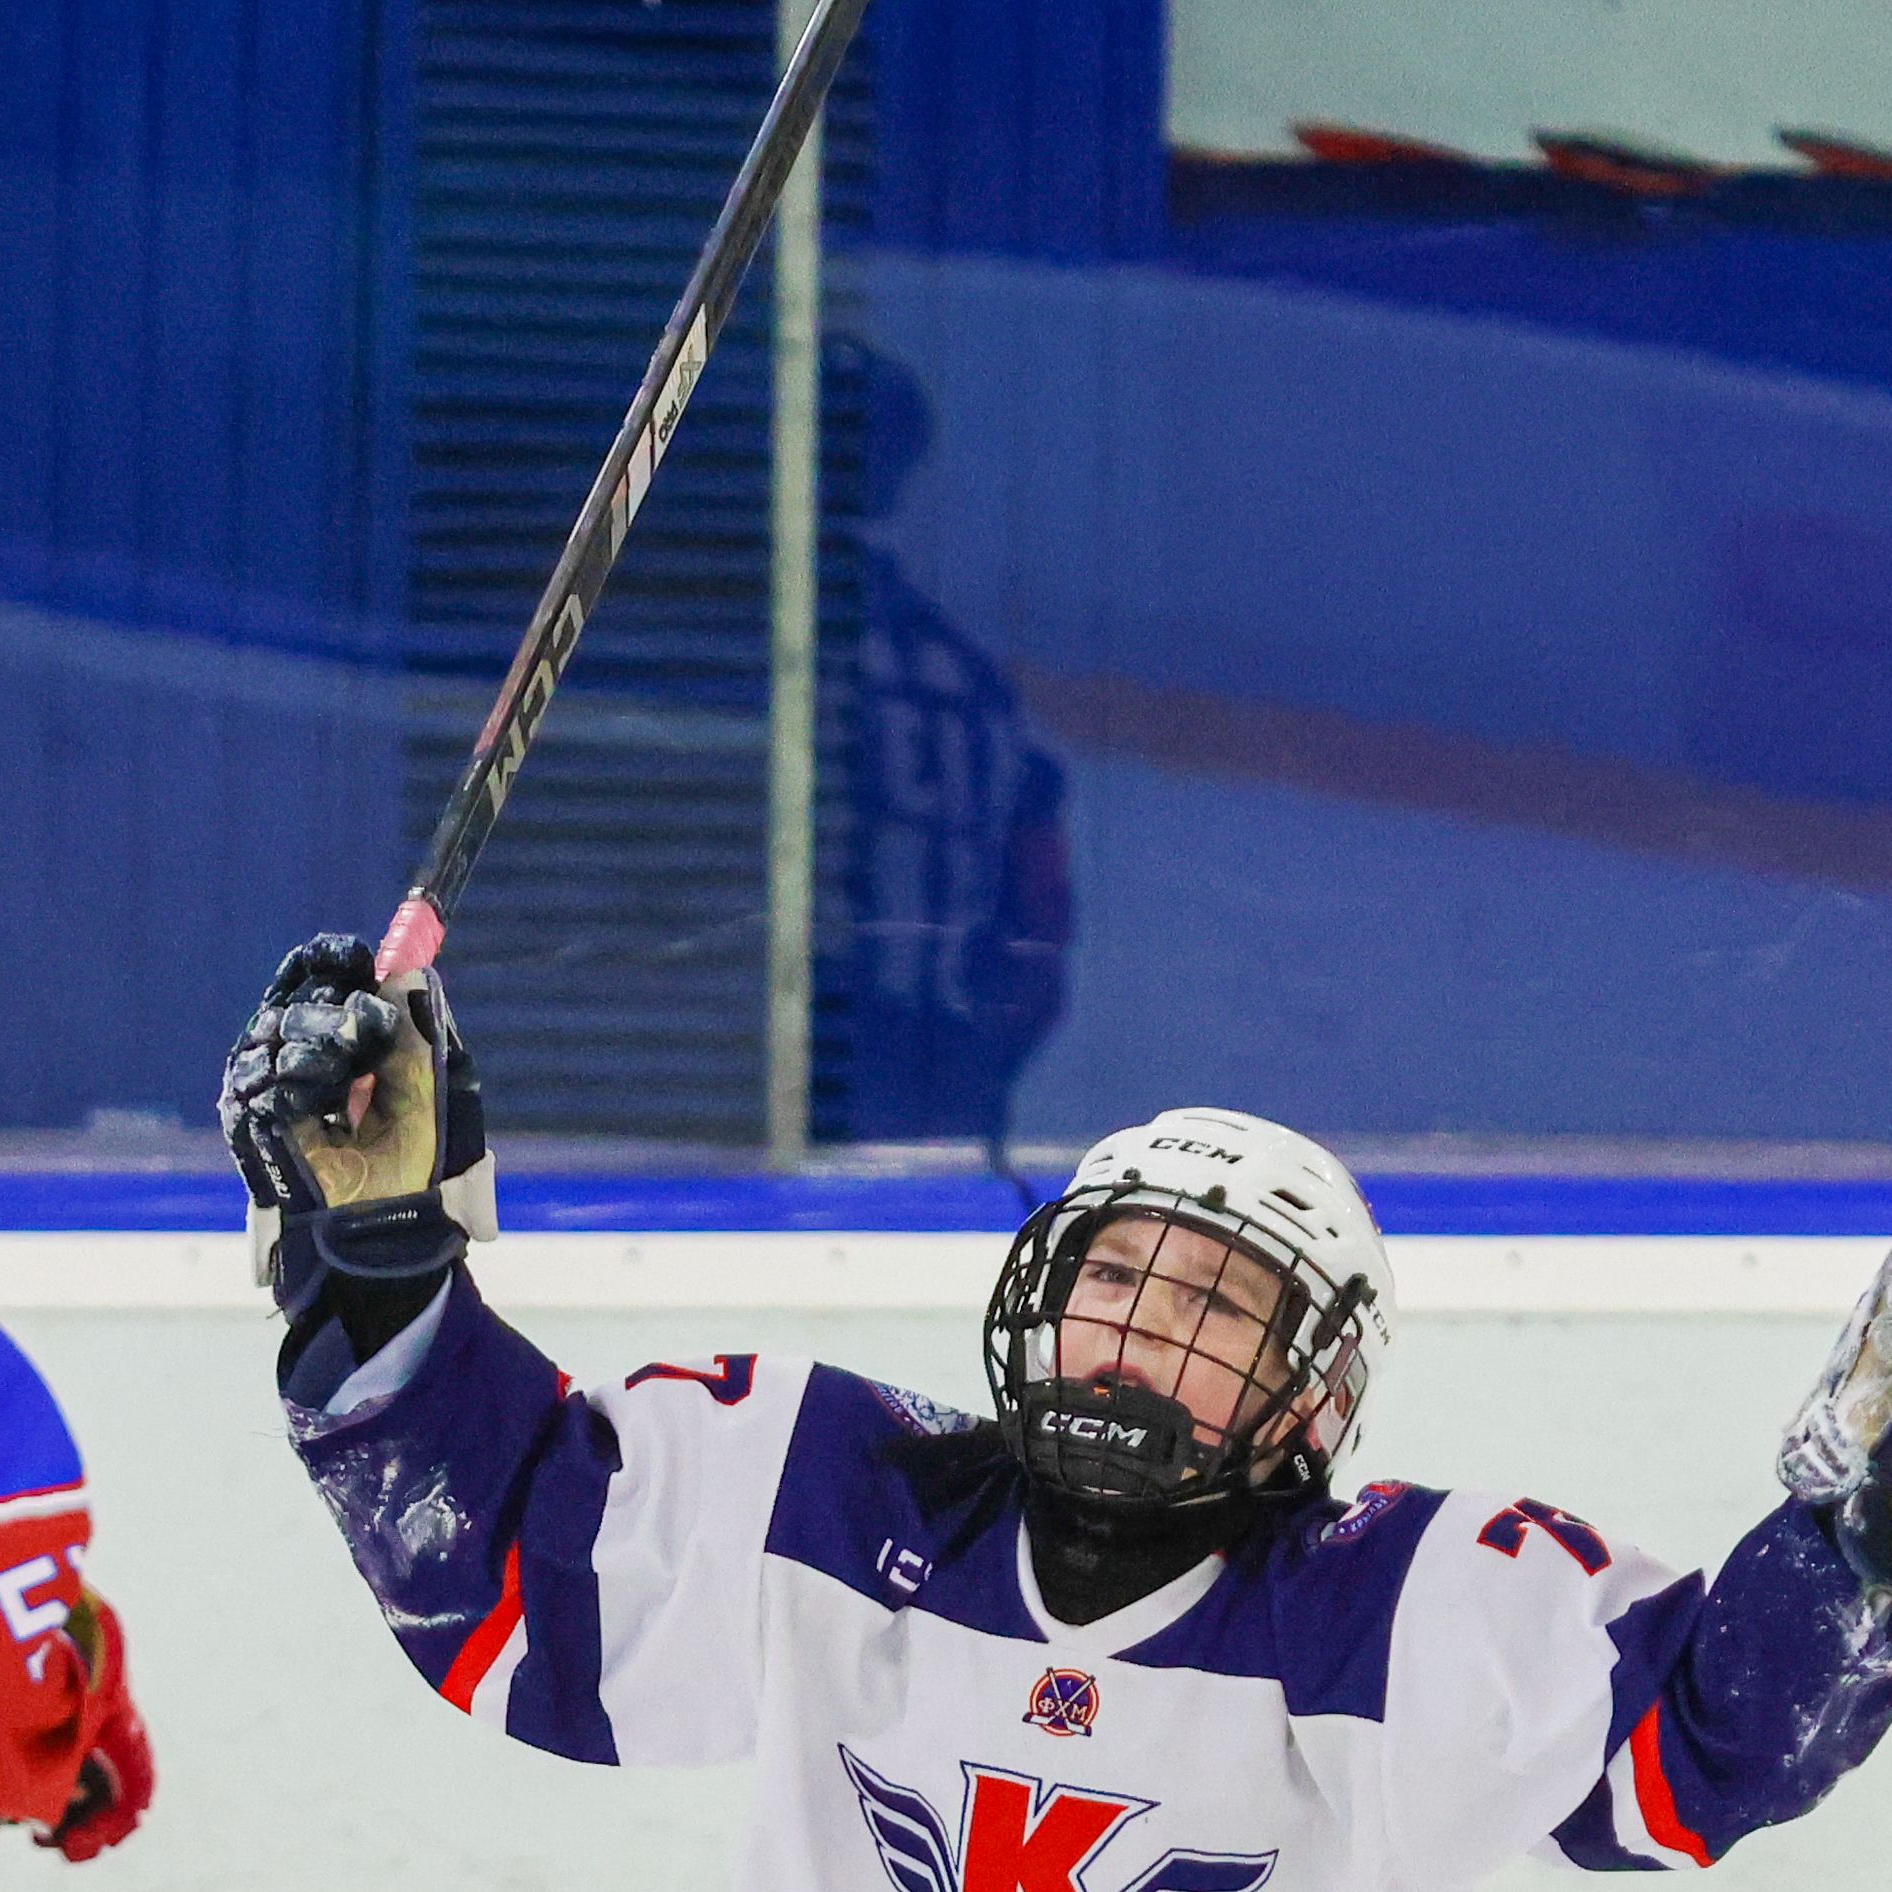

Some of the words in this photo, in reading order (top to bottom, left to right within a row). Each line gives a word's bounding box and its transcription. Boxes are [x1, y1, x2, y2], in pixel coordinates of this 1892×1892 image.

[488, 593, 585, 817] CCM
[1149, 1137, 1245, 1165] CCM
[1040, 1410, 1148, 1448] CCM
[1293, 1454, 1311, 1482] CCM
[1038, 1697, 1088, 1721] ФХМ
